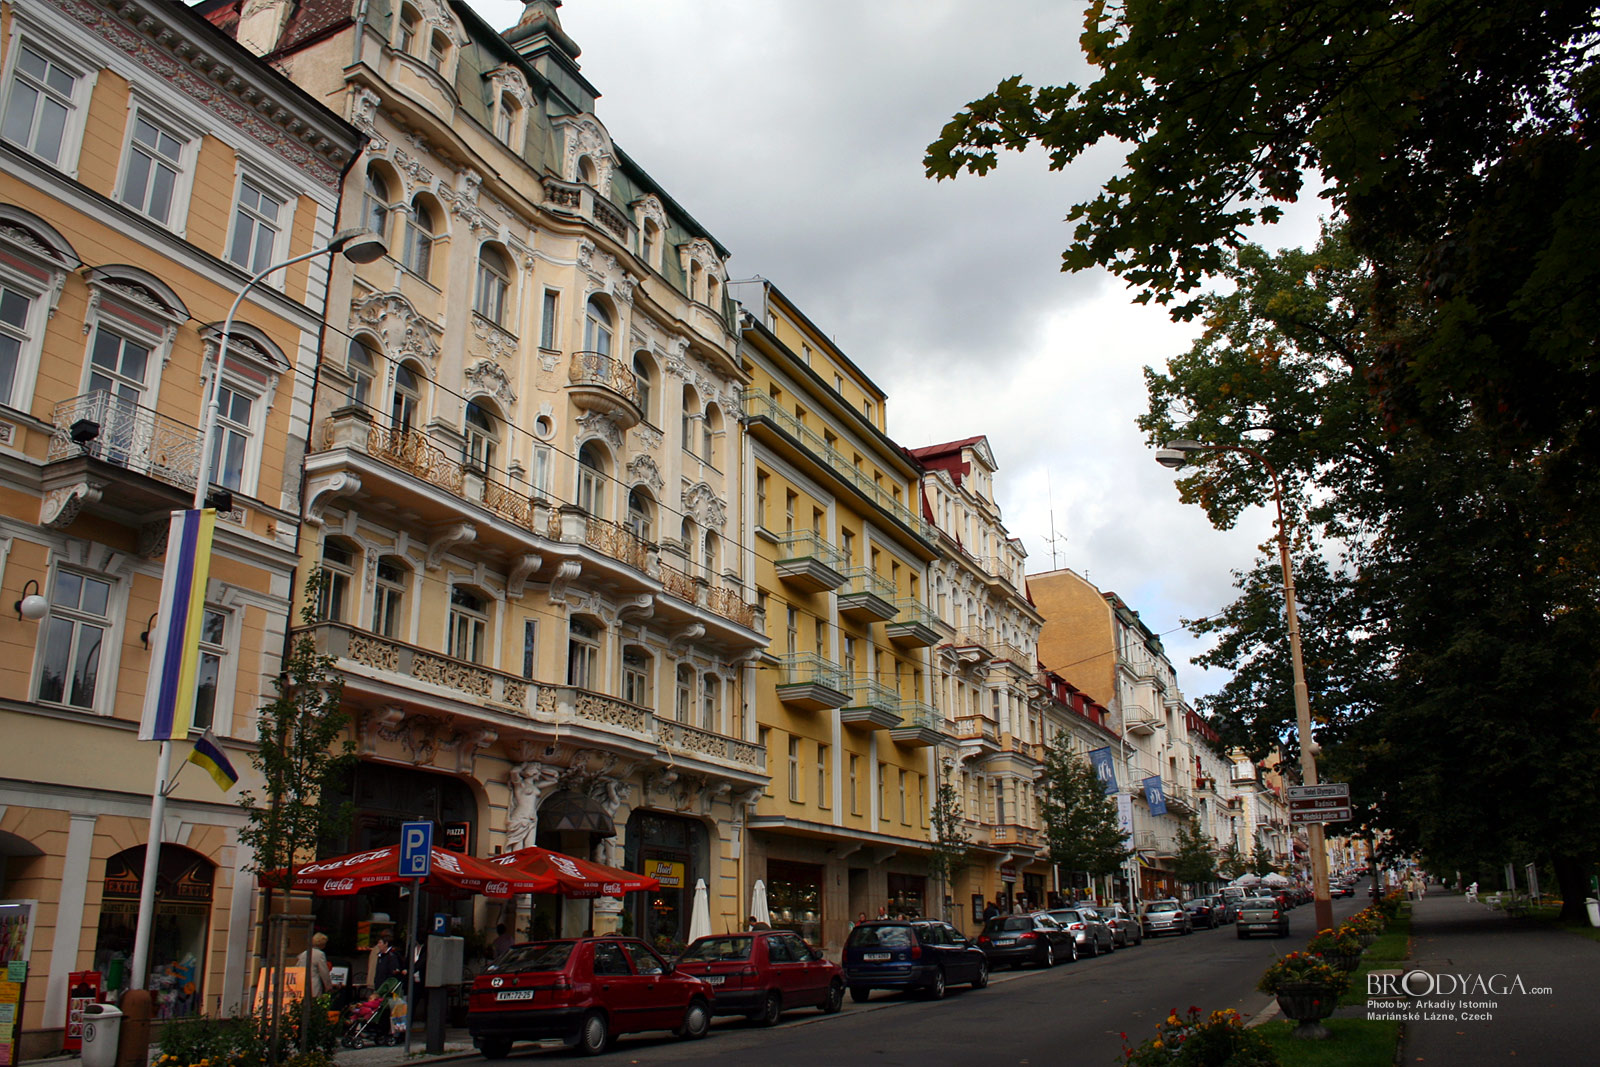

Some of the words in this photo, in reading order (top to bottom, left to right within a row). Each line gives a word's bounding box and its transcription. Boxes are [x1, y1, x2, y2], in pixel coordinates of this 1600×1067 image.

[446, 828, 465, 836] PIAZZA
[405, 829, 425, 860] P
[656, 863, 673, 875] Hotel
[323, 877, 357, 891] Coca-Cola
[434, 916, 444, 931] P
